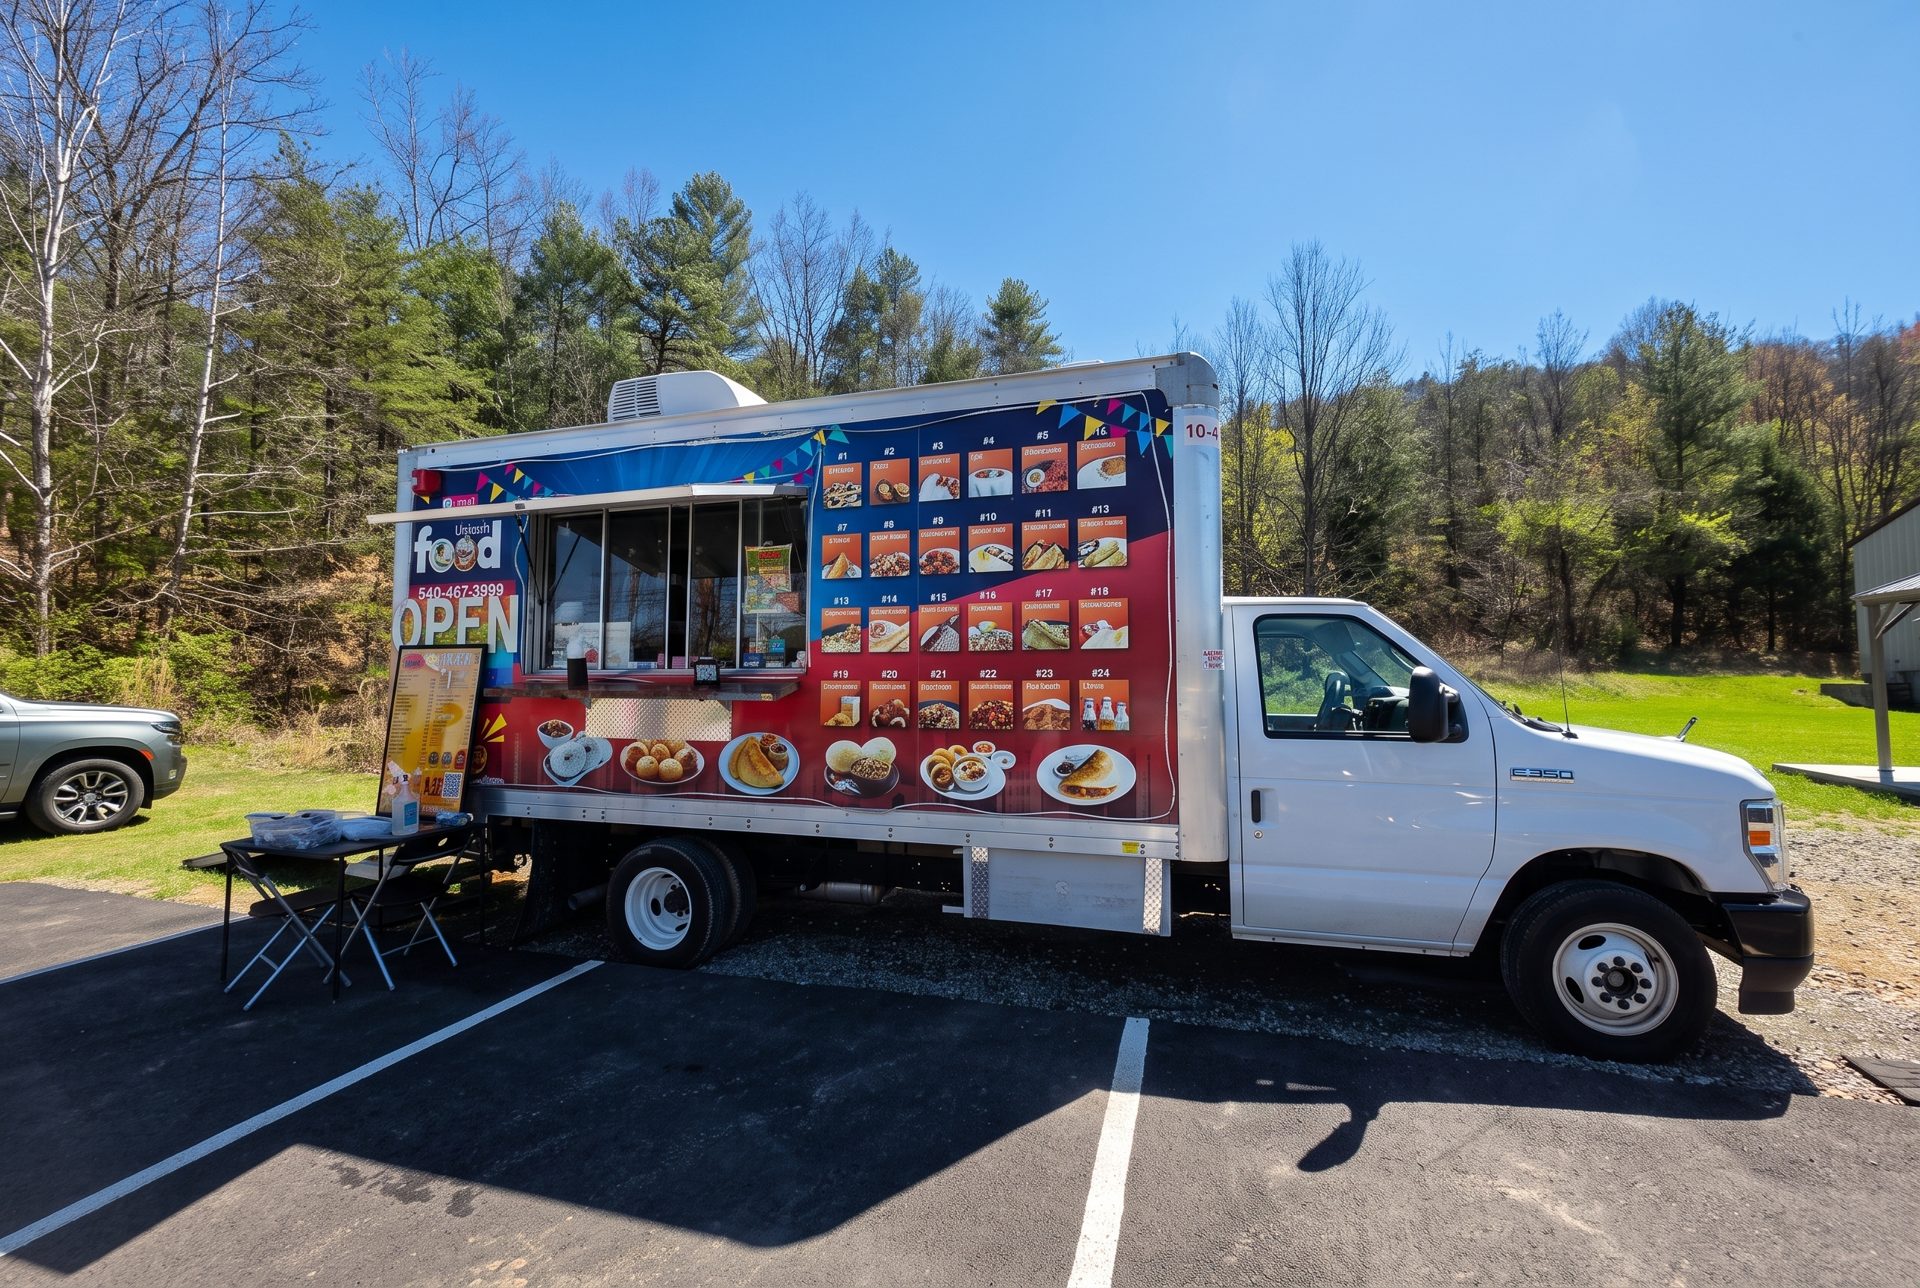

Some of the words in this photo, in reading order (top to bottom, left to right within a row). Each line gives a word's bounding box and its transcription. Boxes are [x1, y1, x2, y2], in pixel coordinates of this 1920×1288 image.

[1036, 430, 1049, 440] #5
[1186, 423, 1219, 441] 10-4
[932, 441, 944, 450] #3
[838, 452, 848, 460] #1
[884, 447, 895, 456] #2
[1035, 509, 1052, 518] #11
[1091, 505, 1110, 514] #13
[932, 516, 944, 525] #9
[980, 512, 997, 522] #10
[837, 523, 848, 532] #7
[883, 520, 895, 529] #8
[418, 583, 504, 600] 540-467-3999
[979, 591, 997, 600] #16
[1035, 589, 1053, 598] #17
[833, 597, 849, 605] #13
[881, 595, 898, 603] #14
[930, 593, 947, 602] #15
[832, 670, 849, 679] #19
[881, 670, 898, 679] #20
[930, 670, 947, 679] #21
[979, 670, 997, 678] #22
[1035, 669, 1054, 678] #23
[1091, 668, 1110, 678] #24
